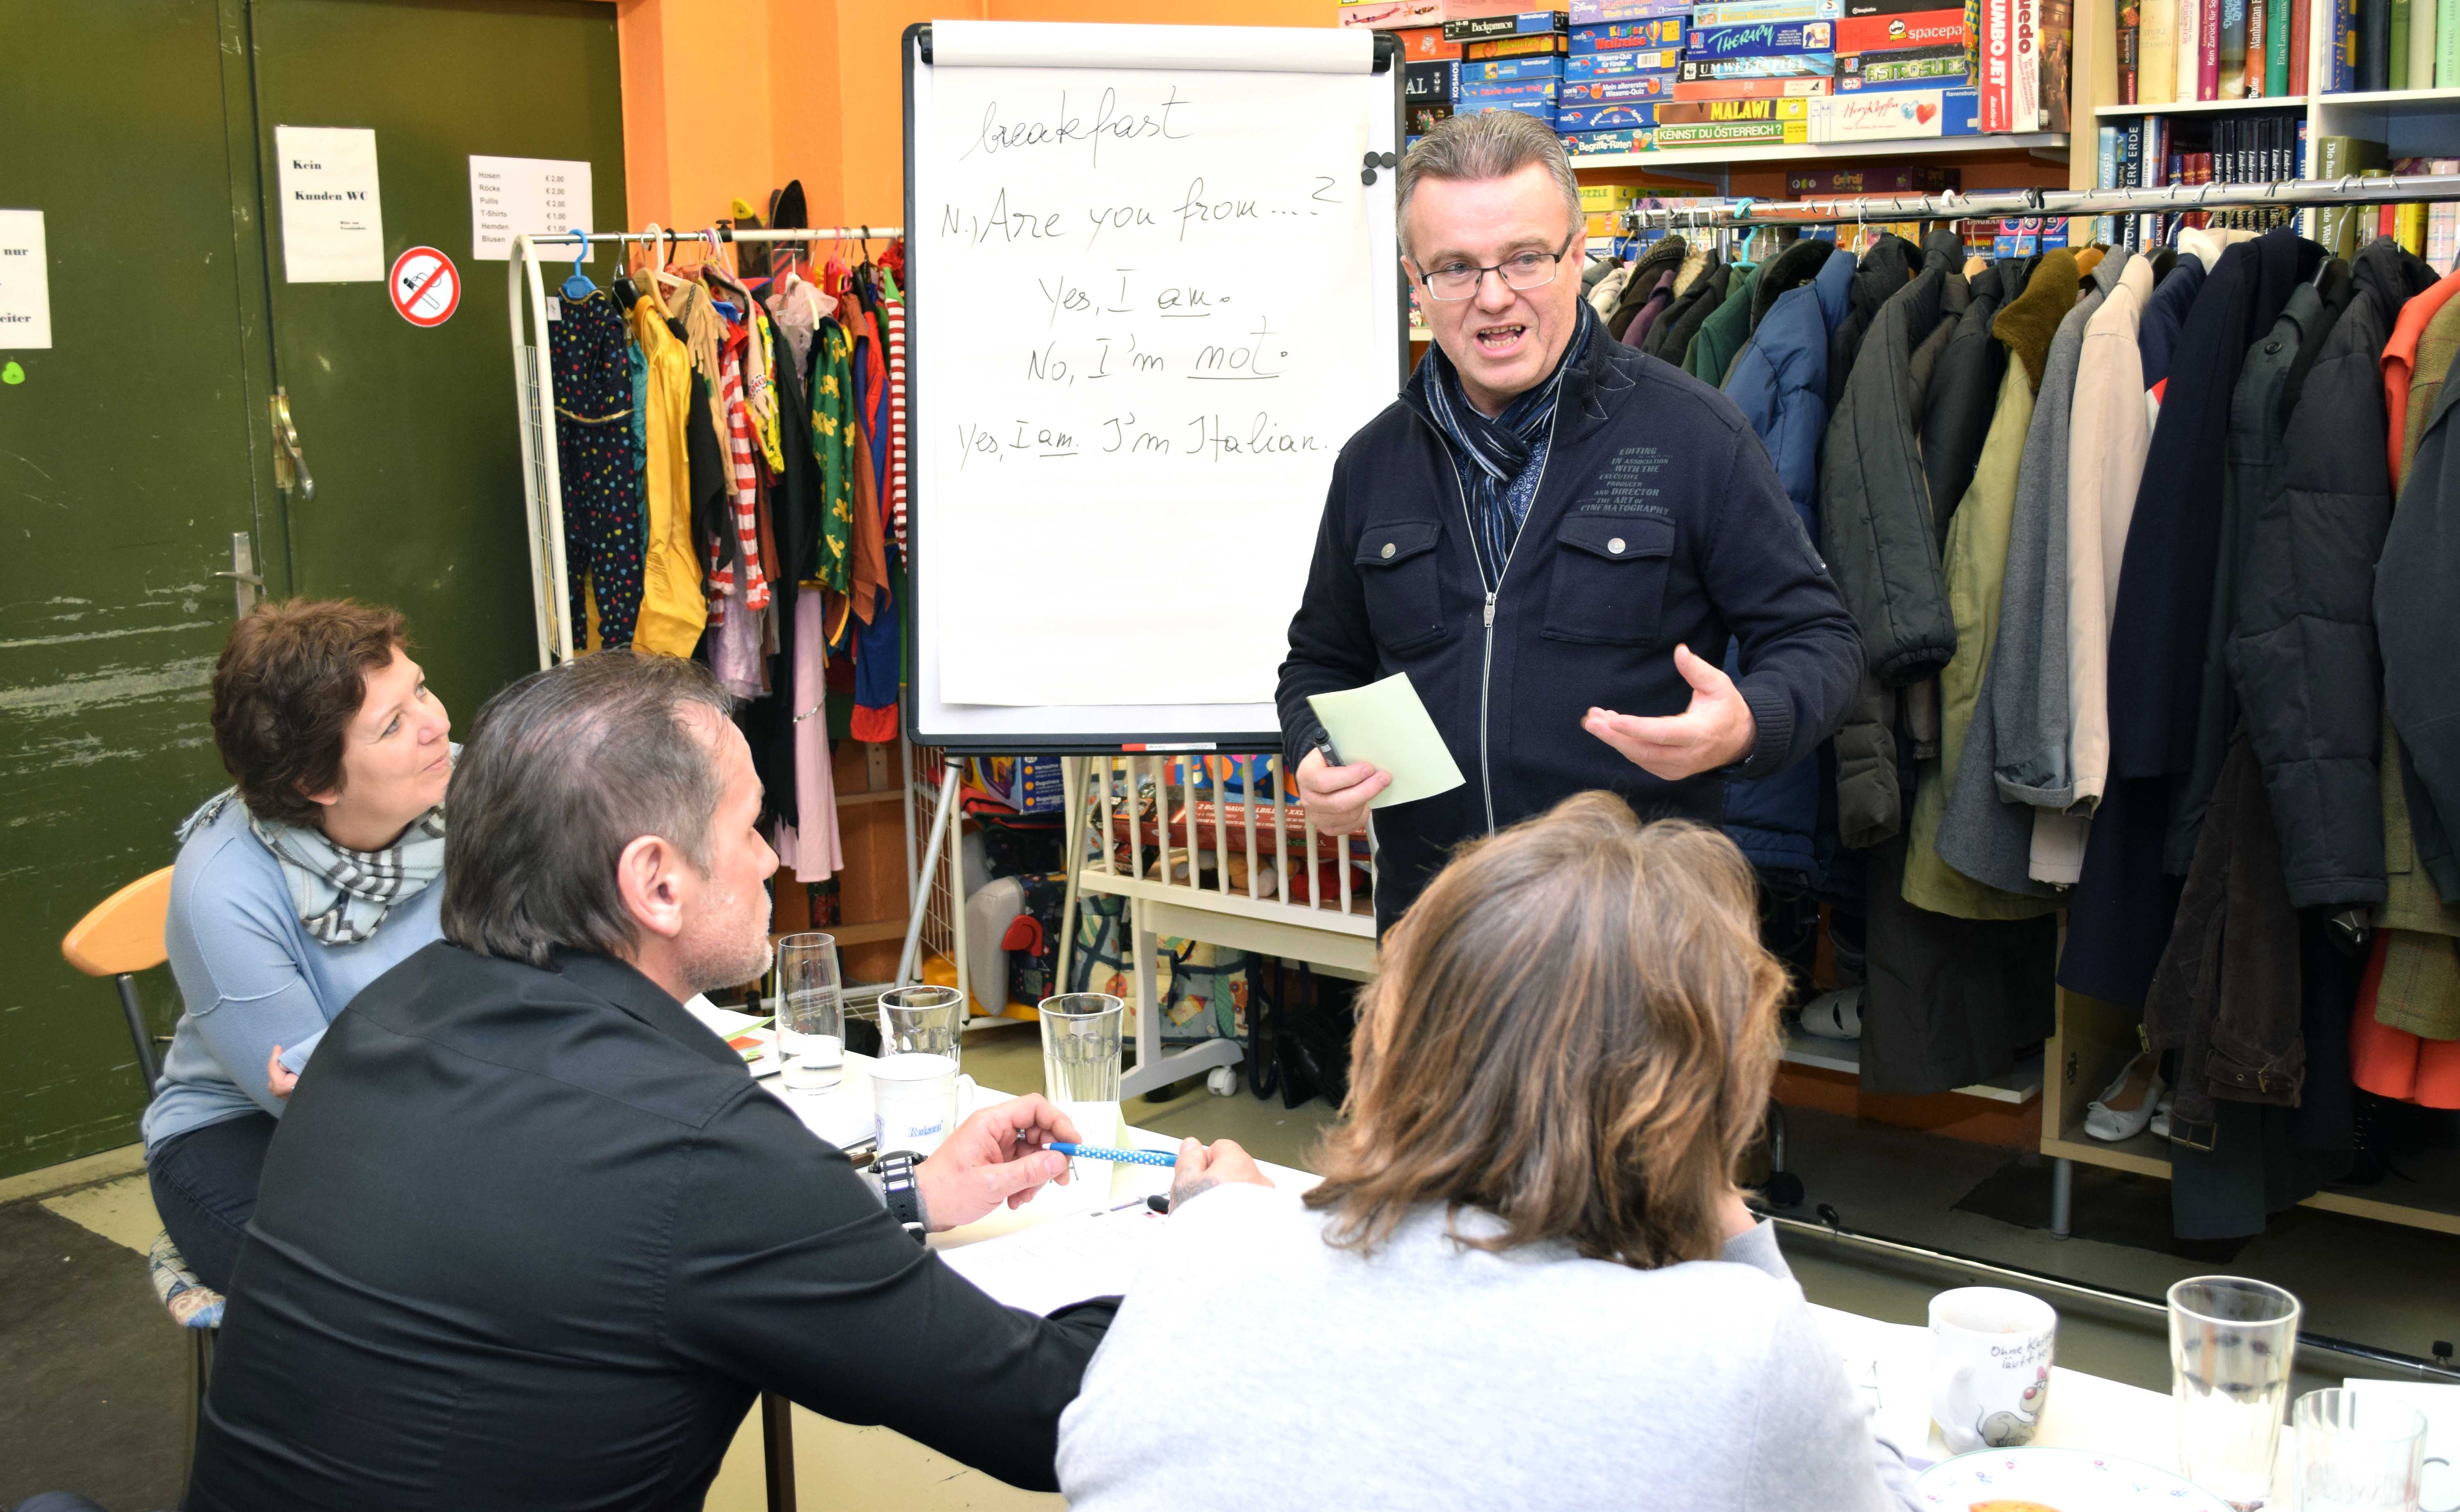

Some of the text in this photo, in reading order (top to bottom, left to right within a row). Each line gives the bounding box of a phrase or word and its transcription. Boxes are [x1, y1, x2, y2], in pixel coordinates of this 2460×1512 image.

[1570, 1, 1597, 13] Disney
[1471, 21, 1512, 34] Backgammon
[1609, 24, 1644, 37] Kinder
[2250, 7, 2262, 49] Manhattan
[1595, 35, 1647, 50] Weltreise
[1690, 32, 1705, 45] MB
[1708, 25, 1775, 53] THERAPY
[1597, 53, 1633, 62] Wissens-Quiz
[1845, 58, 1859, 69] MB
[2277, 48, 2285, 66] Eine
[1700, 59, 1804, 74] UMWELTSPIEL
[1866, 57, 1968, 83] ASTROSLIDE
[1990, 58, 2006, 87] JET
[1606, 89, 1644, 97] Wissens-Quiz
[2249, 77, 2259, 99] Texier
[1710, 100, 1770, 121] MALAWI
[959, 85, 1192, 168] breakfast
[1590, 112, 1603, 127] Mein
[1659, 129, 1697, 141] KENNST
[1699, 128, 1712, 139] DU
[1714, 125, 1774, 138] ÖSTERREICH
[1775, 124, 1782, 134] ?
[1579, 141, 1632, 153] Begriffe-Raten
[2128, 127, 2139, 157] ERDE
[2327, 143, 2335, 159] Die
[293, 159, 321, 169] Kein
[295, 191, 367, 200] Kunden WC
[481, 209, 507, 217] T-Shirts
[979, 177, 1259, 253] Are you from
[2322, 224, 2331, 246] Welt
[1107, 268, 1136, 313] I
[1158, 287, 1230, 317] am.
[1028, 315, 1288, 387] No, I'm not.
[1009, 420, 1031, 449] I
[1102, 412, 1169, 454] I'm
[1611, 487, 1660, 497] DIRECTOR
[1581, 503, 1670, 516] CINEMATOGRAPHY
[908, 1124, 942, 1138] Reisen
[1991, 1346, 2023, 1357] Ohne
